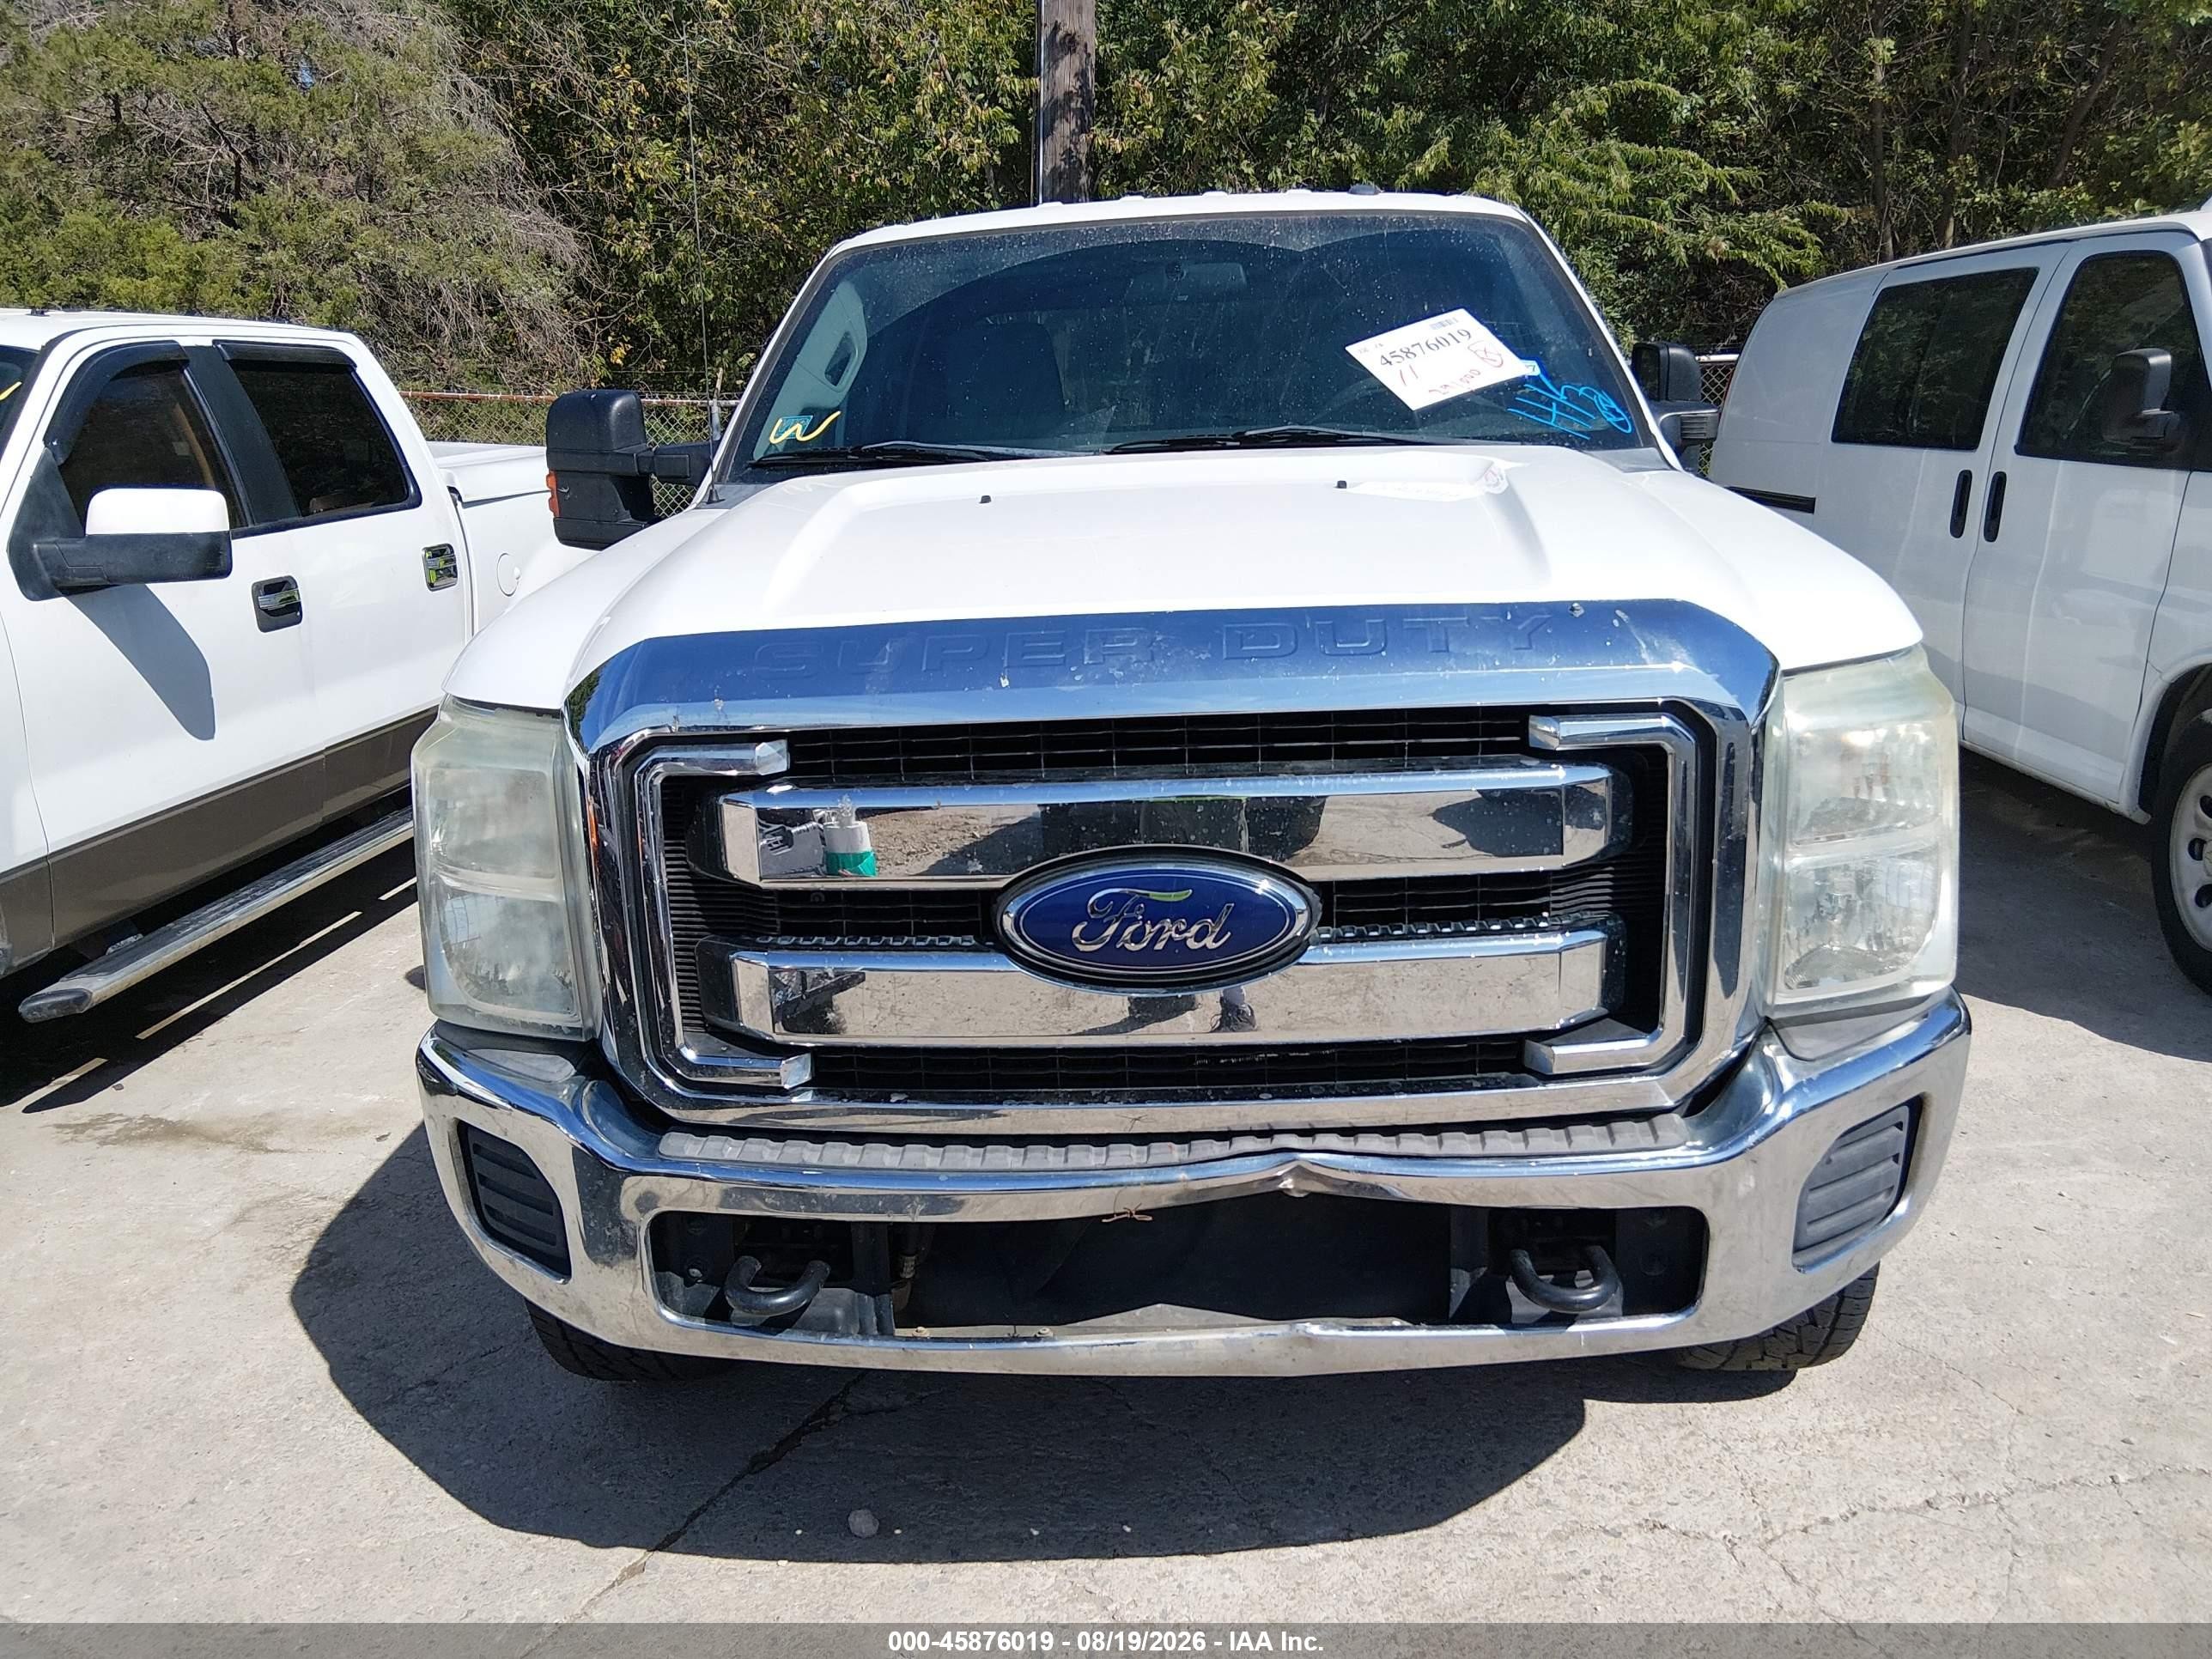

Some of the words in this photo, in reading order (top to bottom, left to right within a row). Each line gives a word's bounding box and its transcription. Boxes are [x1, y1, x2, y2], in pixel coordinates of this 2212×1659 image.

[1380, 328, 1472, 367] 45876019
[753, 625, 1156, 680] SUPER
[1223, 614, 1553, 660] DUTY
[1072, 888, 1235, 953] Ford
